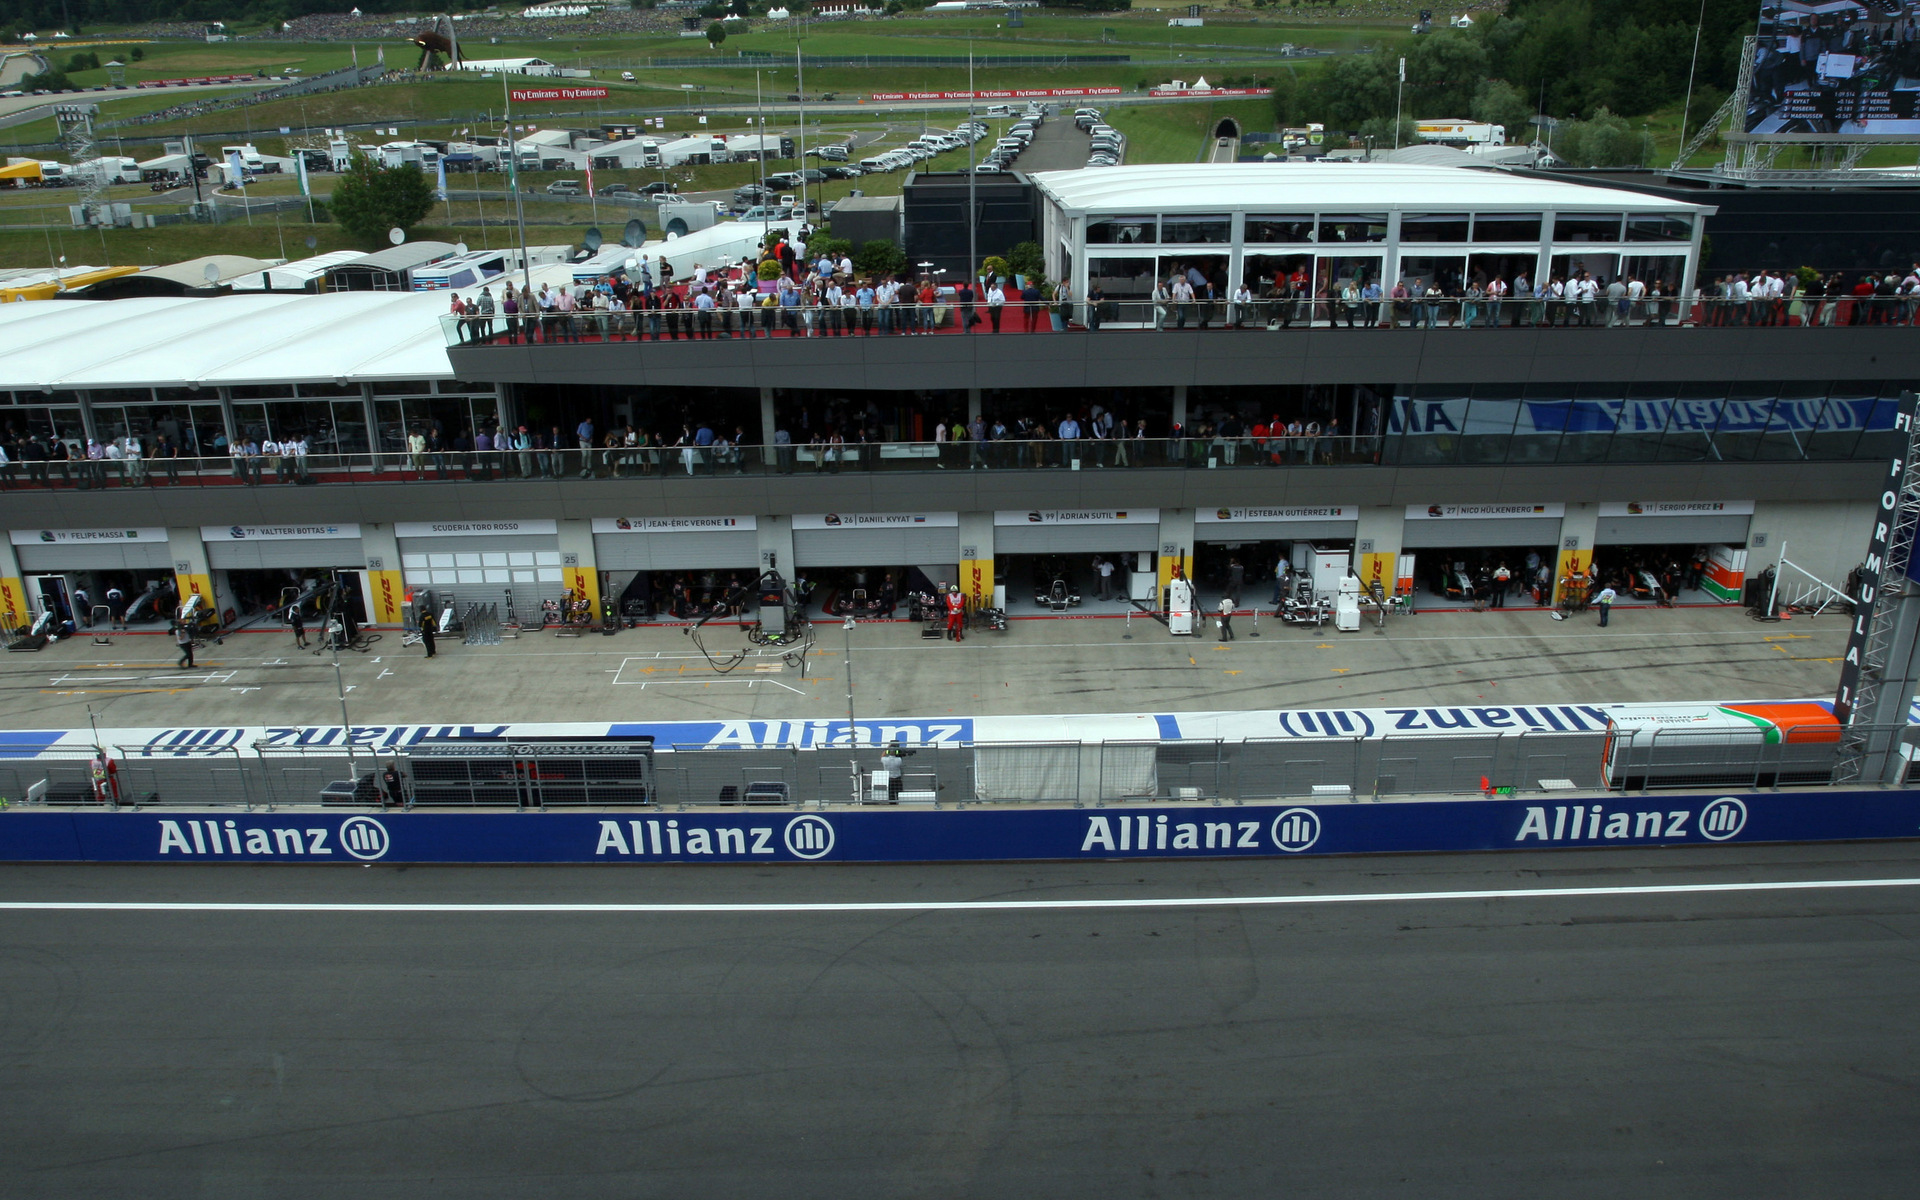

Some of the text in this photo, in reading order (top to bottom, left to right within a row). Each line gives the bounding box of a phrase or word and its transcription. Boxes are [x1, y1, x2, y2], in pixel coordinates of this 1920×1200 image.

[513, 90, 559, 100] Fly Emirates
[562, 88, 606, 99] Fly Emirates
[1894, 412, 1911, 432] F1
[1060, 512, 1090, 520] ADRIAN
[1248, 509, 1284, 517] ESTEBAN
[633, 520, 642, 528] 25
[691, 519, 722, 527] VERGNE
[886, 515, 910, 523] KVYAT
[260, 527, 295, 535] VALTTERI
[297, 526, 325, 534] BOTTAS
[432, 524, 470, 532] SCUDERIA
[472, 523, 492, 531] TORO
[71, 531, 97, 539] FELIPE
[1164, 545, 1175, 553] 22
[1361, 542, 1371, 550] 21
[369, 560, 381, 568] 26
[565, 556, 576, 564] 25
[177, 563, 188, 571] 27
[381, 578, 395, 615] DHL
[702, 722, 963, 751] Allianz
[1514, 805, 1691, 842] Allianz
[158, 819, 333, 855] Allianz
[595, 819, 775, 855] Allianz
[1080, 815, 1260, 852] Allianz
